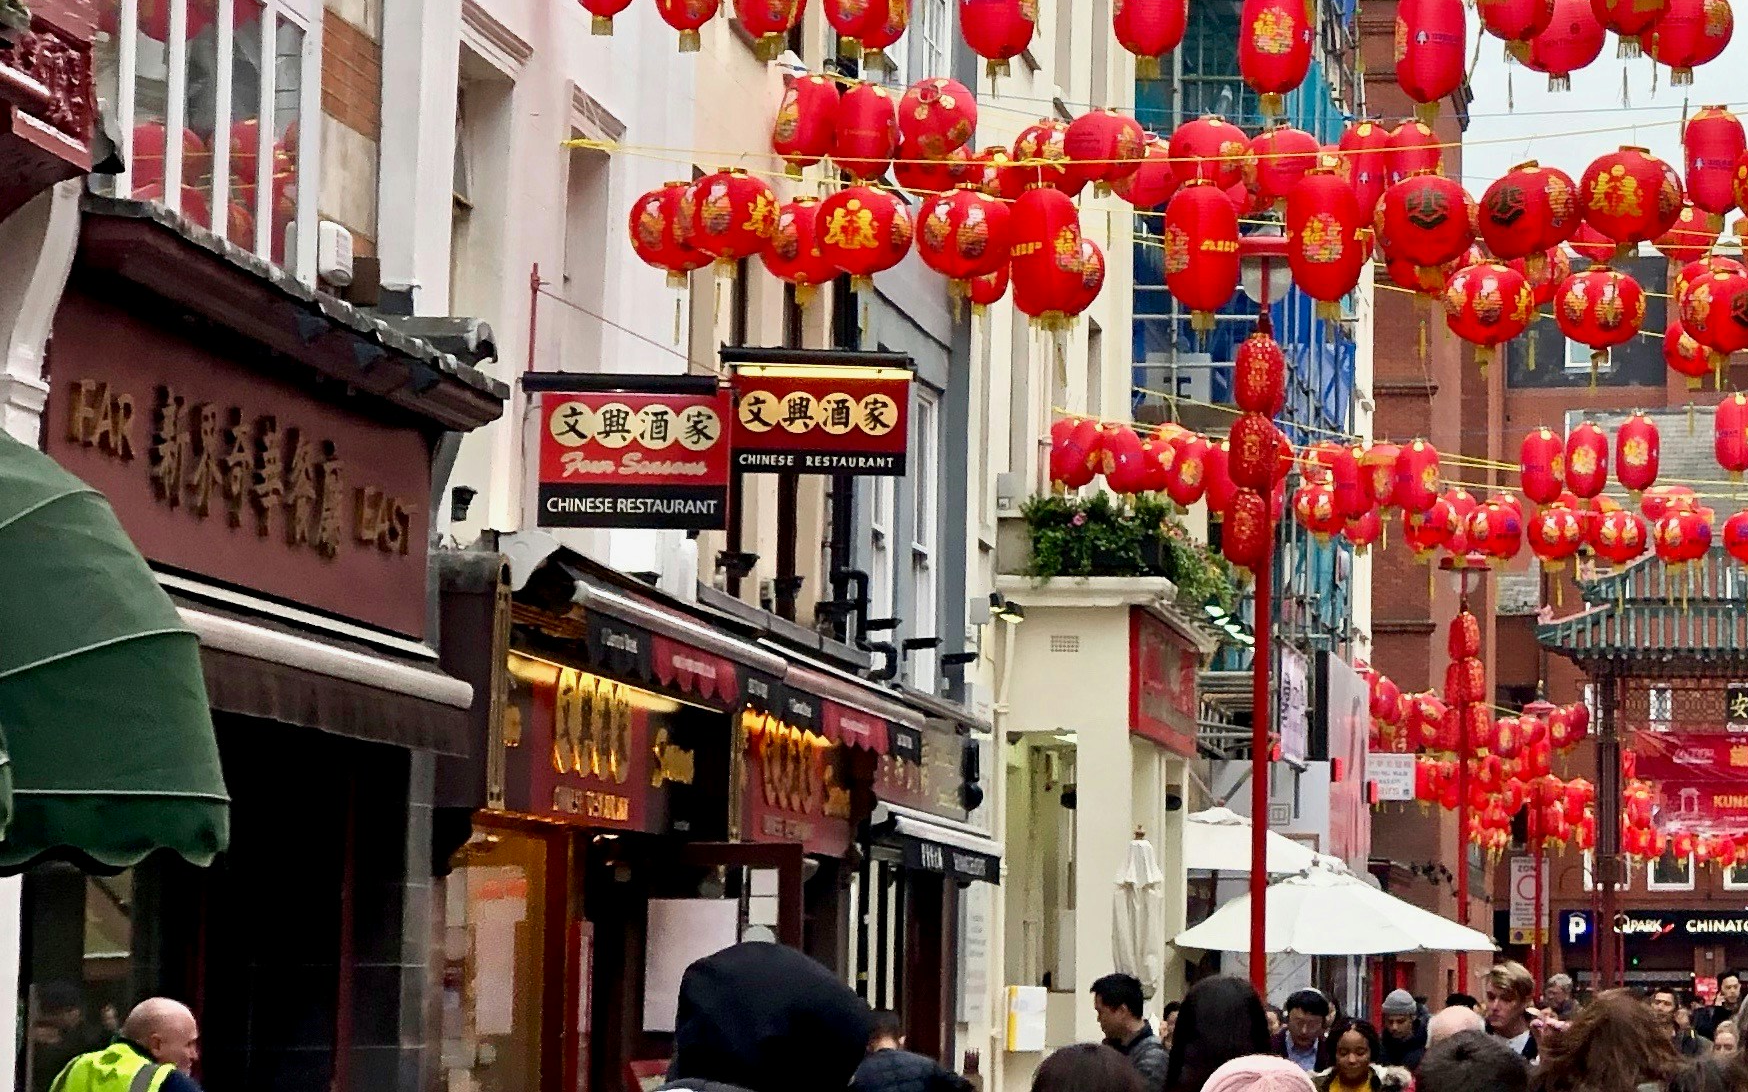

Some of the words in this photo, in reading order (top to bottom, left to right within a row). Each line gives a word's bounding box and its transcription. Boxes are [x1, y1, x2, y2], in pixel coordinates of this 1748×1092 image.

[70, 379, 134, 458] FAR
[559, 452, 616, 477] Four
[617, 452, 707, 476] Seasons
[739, 454, 795, 467] CHINESE
[805, 455, 895, 469] RESTAURANT
[356, 485, 417, 551] EAST
[546, 497, 614, 513] CHINESE
[616, 498, 718, 515] RESTAURANT
